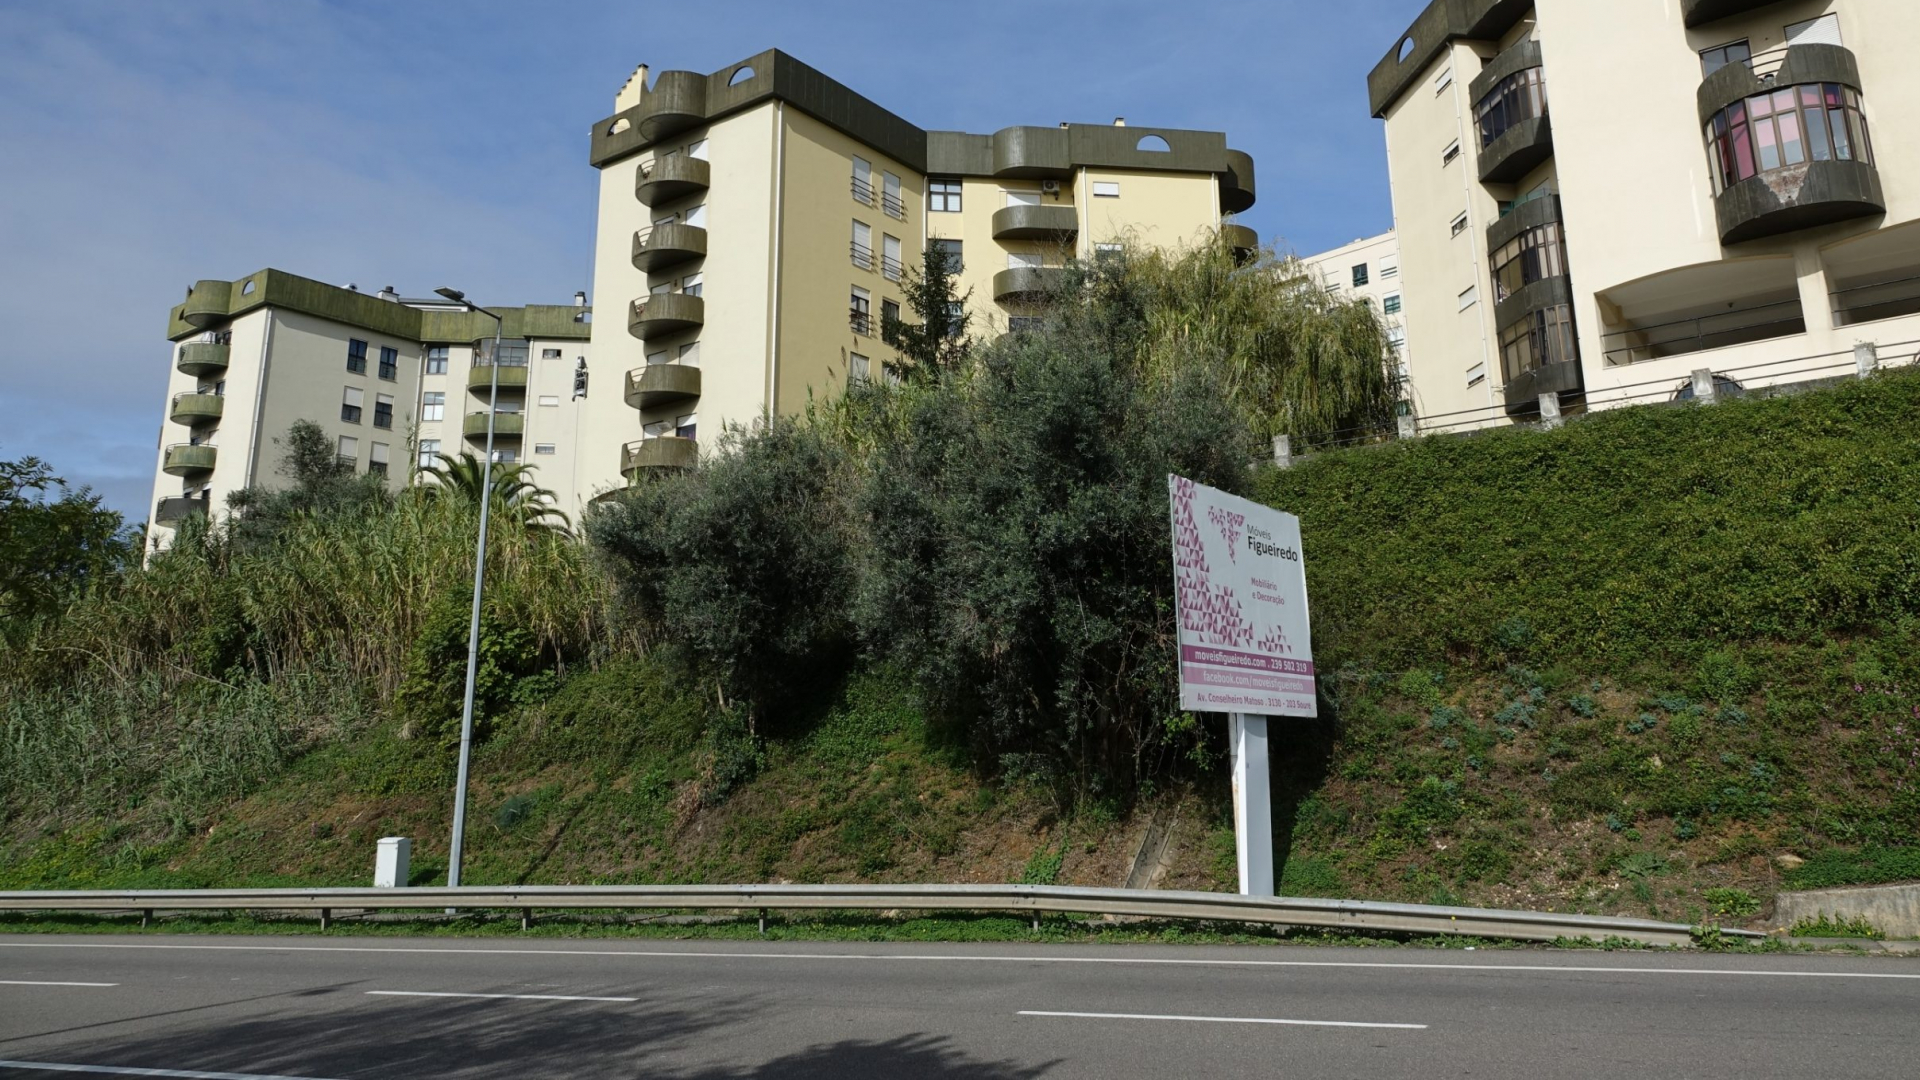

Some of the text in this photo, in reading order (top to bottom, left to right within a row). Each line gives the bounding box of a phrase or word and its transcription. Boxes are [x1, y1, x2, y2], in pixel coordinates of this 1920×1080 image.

[1247, 524, 1271, 540] Móveis
[1248, 536, 1297, 561] Figueiredo
[1251, 577, 1277, 591] Mobiliário
[1257, 591, 1285, 605] Decoração
[1195, 650, 1266, 668] moveisfigueiredo.com
[1271, 658, 1283, 670] 239
[1284, 660, 1295, 671] 502
[1296, 662, 1307, 673] 319
[1197, 692, 1207, 702] Av.
[1208, 693, 1242, 704] Conselheiro
[1244, 696, 1264, 706] Matoso
